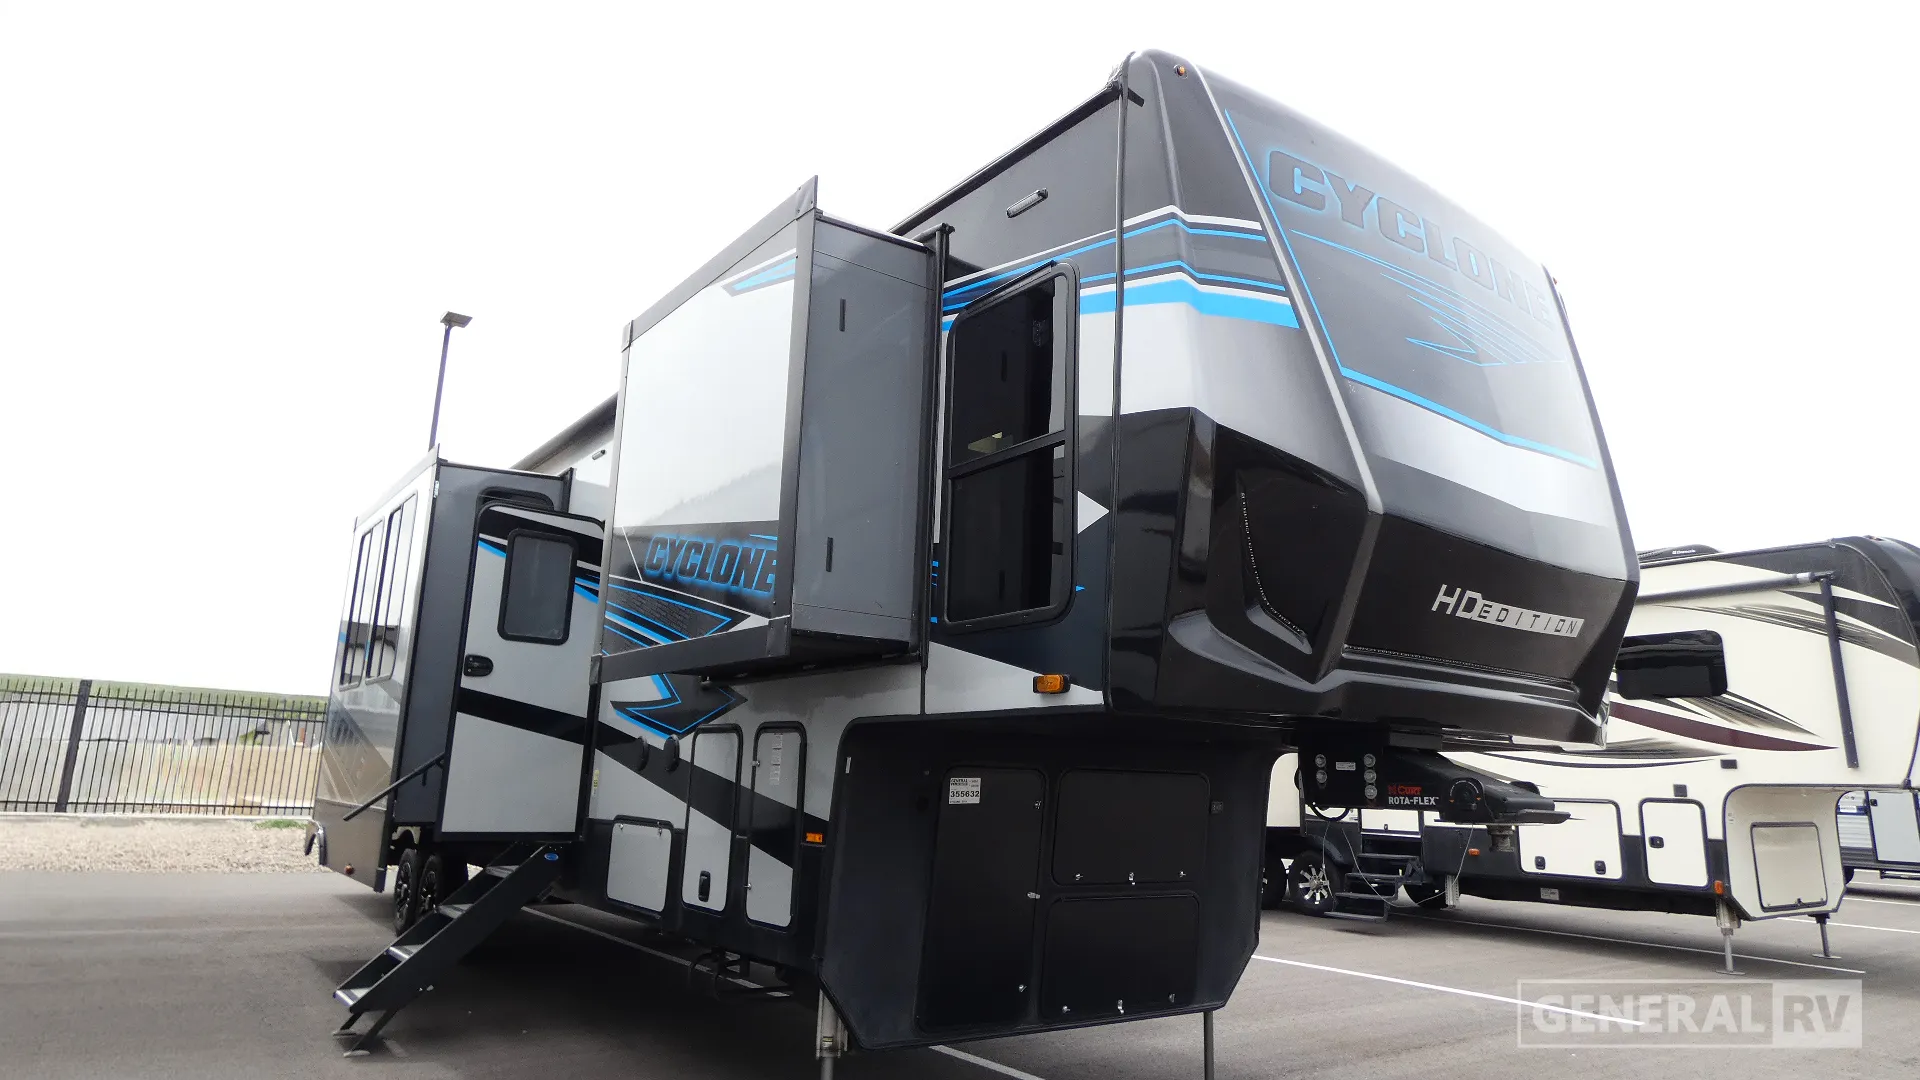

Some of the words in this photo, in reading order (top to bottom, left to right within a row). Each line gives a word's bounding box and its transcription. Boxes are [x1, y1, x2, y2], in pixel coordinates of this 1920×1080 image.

[1268, 149, 1555, 331] CYCLONE
[644, 536, 777, 593] CYCLONE
[1476, 602, 1579, 635] EDITION
[950, 790, 980, 798] 355632
